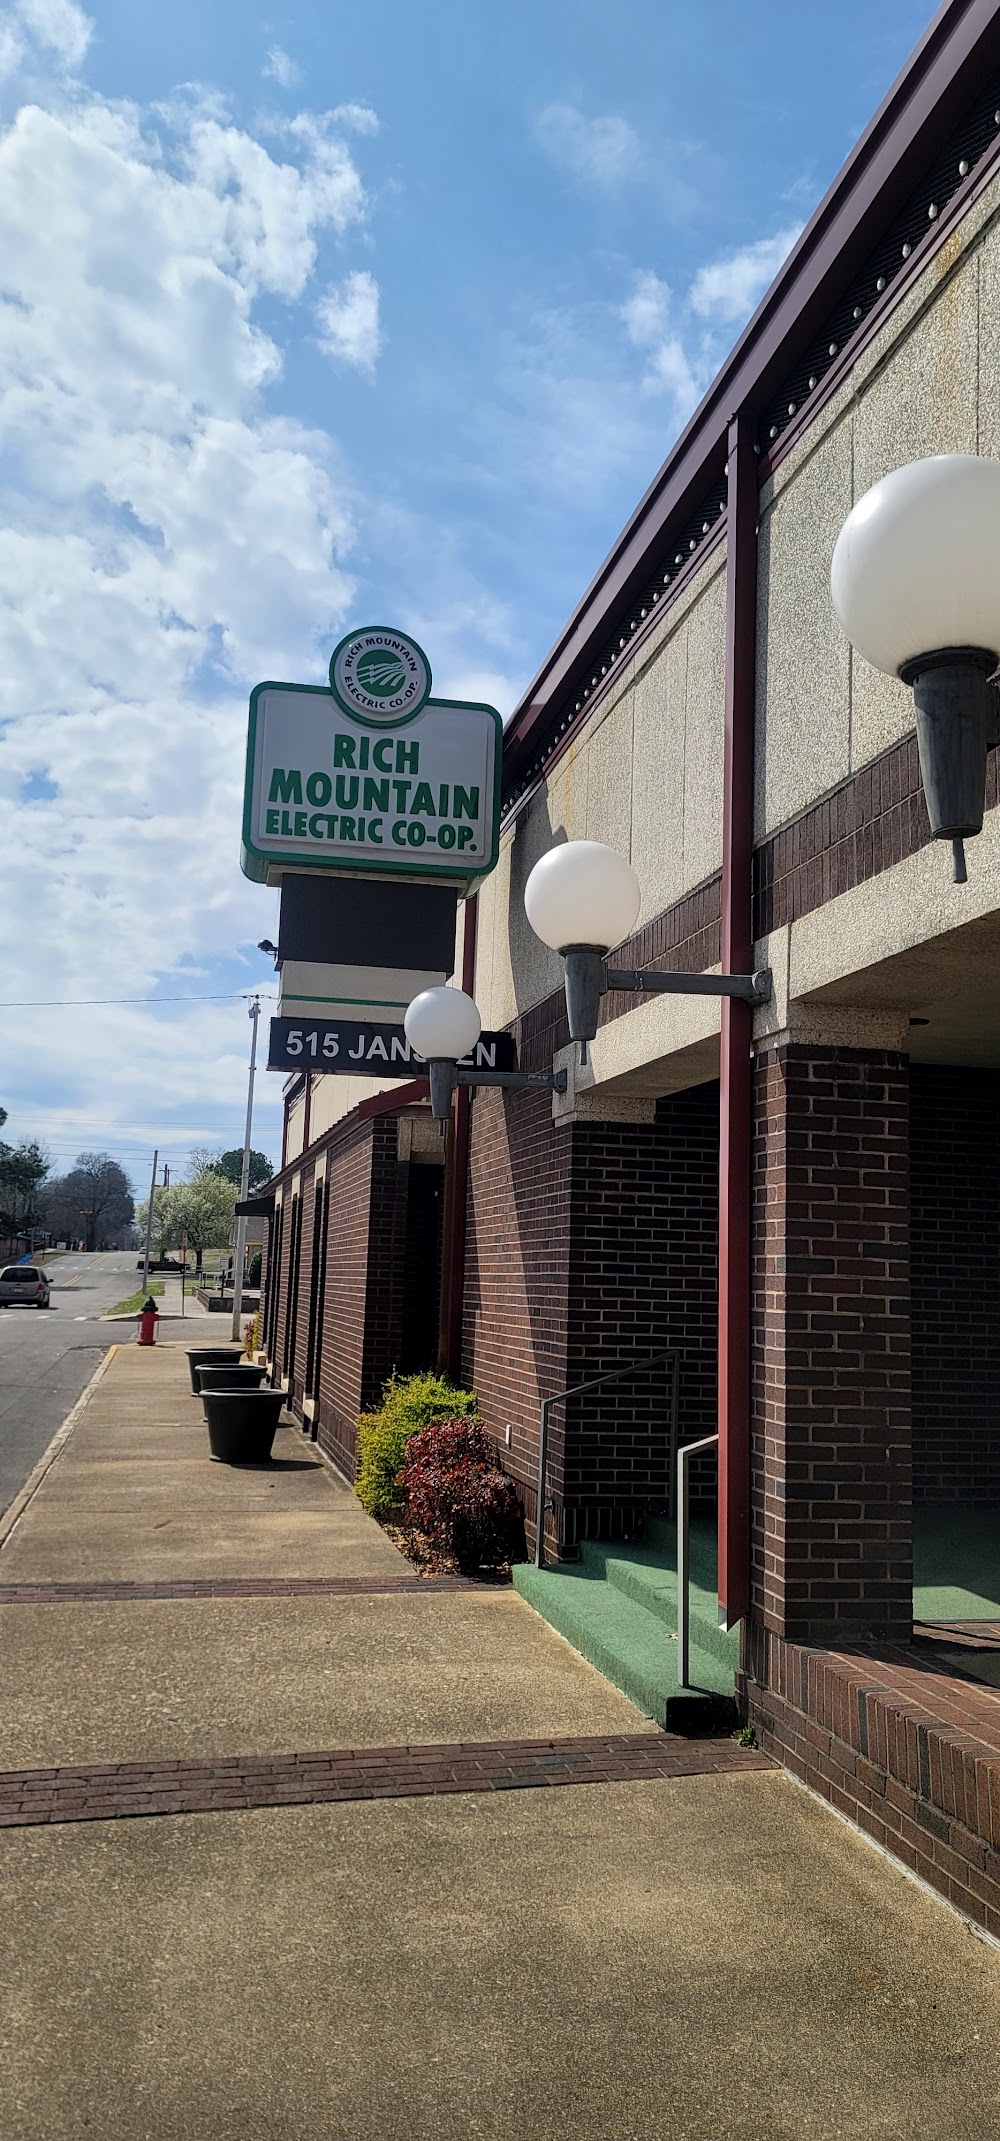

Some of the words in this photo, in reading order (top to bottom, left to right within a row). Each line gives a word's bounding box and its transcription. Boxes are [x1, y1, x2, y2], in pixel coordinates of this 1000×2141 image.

[345, 643, 363, 667] RICH
[366, 637, 417, 672] MOUNTAIN
[345, 676, 385, 709] ELECTRIC
[389, 681, 418, 707] CO-OP.
[333, 734, 420, 775] RICH
[268, 768, 480, 820] MOUNTAIN
[266, 809, 383, 844] ELECTRIC
[391, 820, 477, 852] CO-OP.
[285, 1030, 339, 1058] 515
[348, 1034, 496, 1067] JANN
